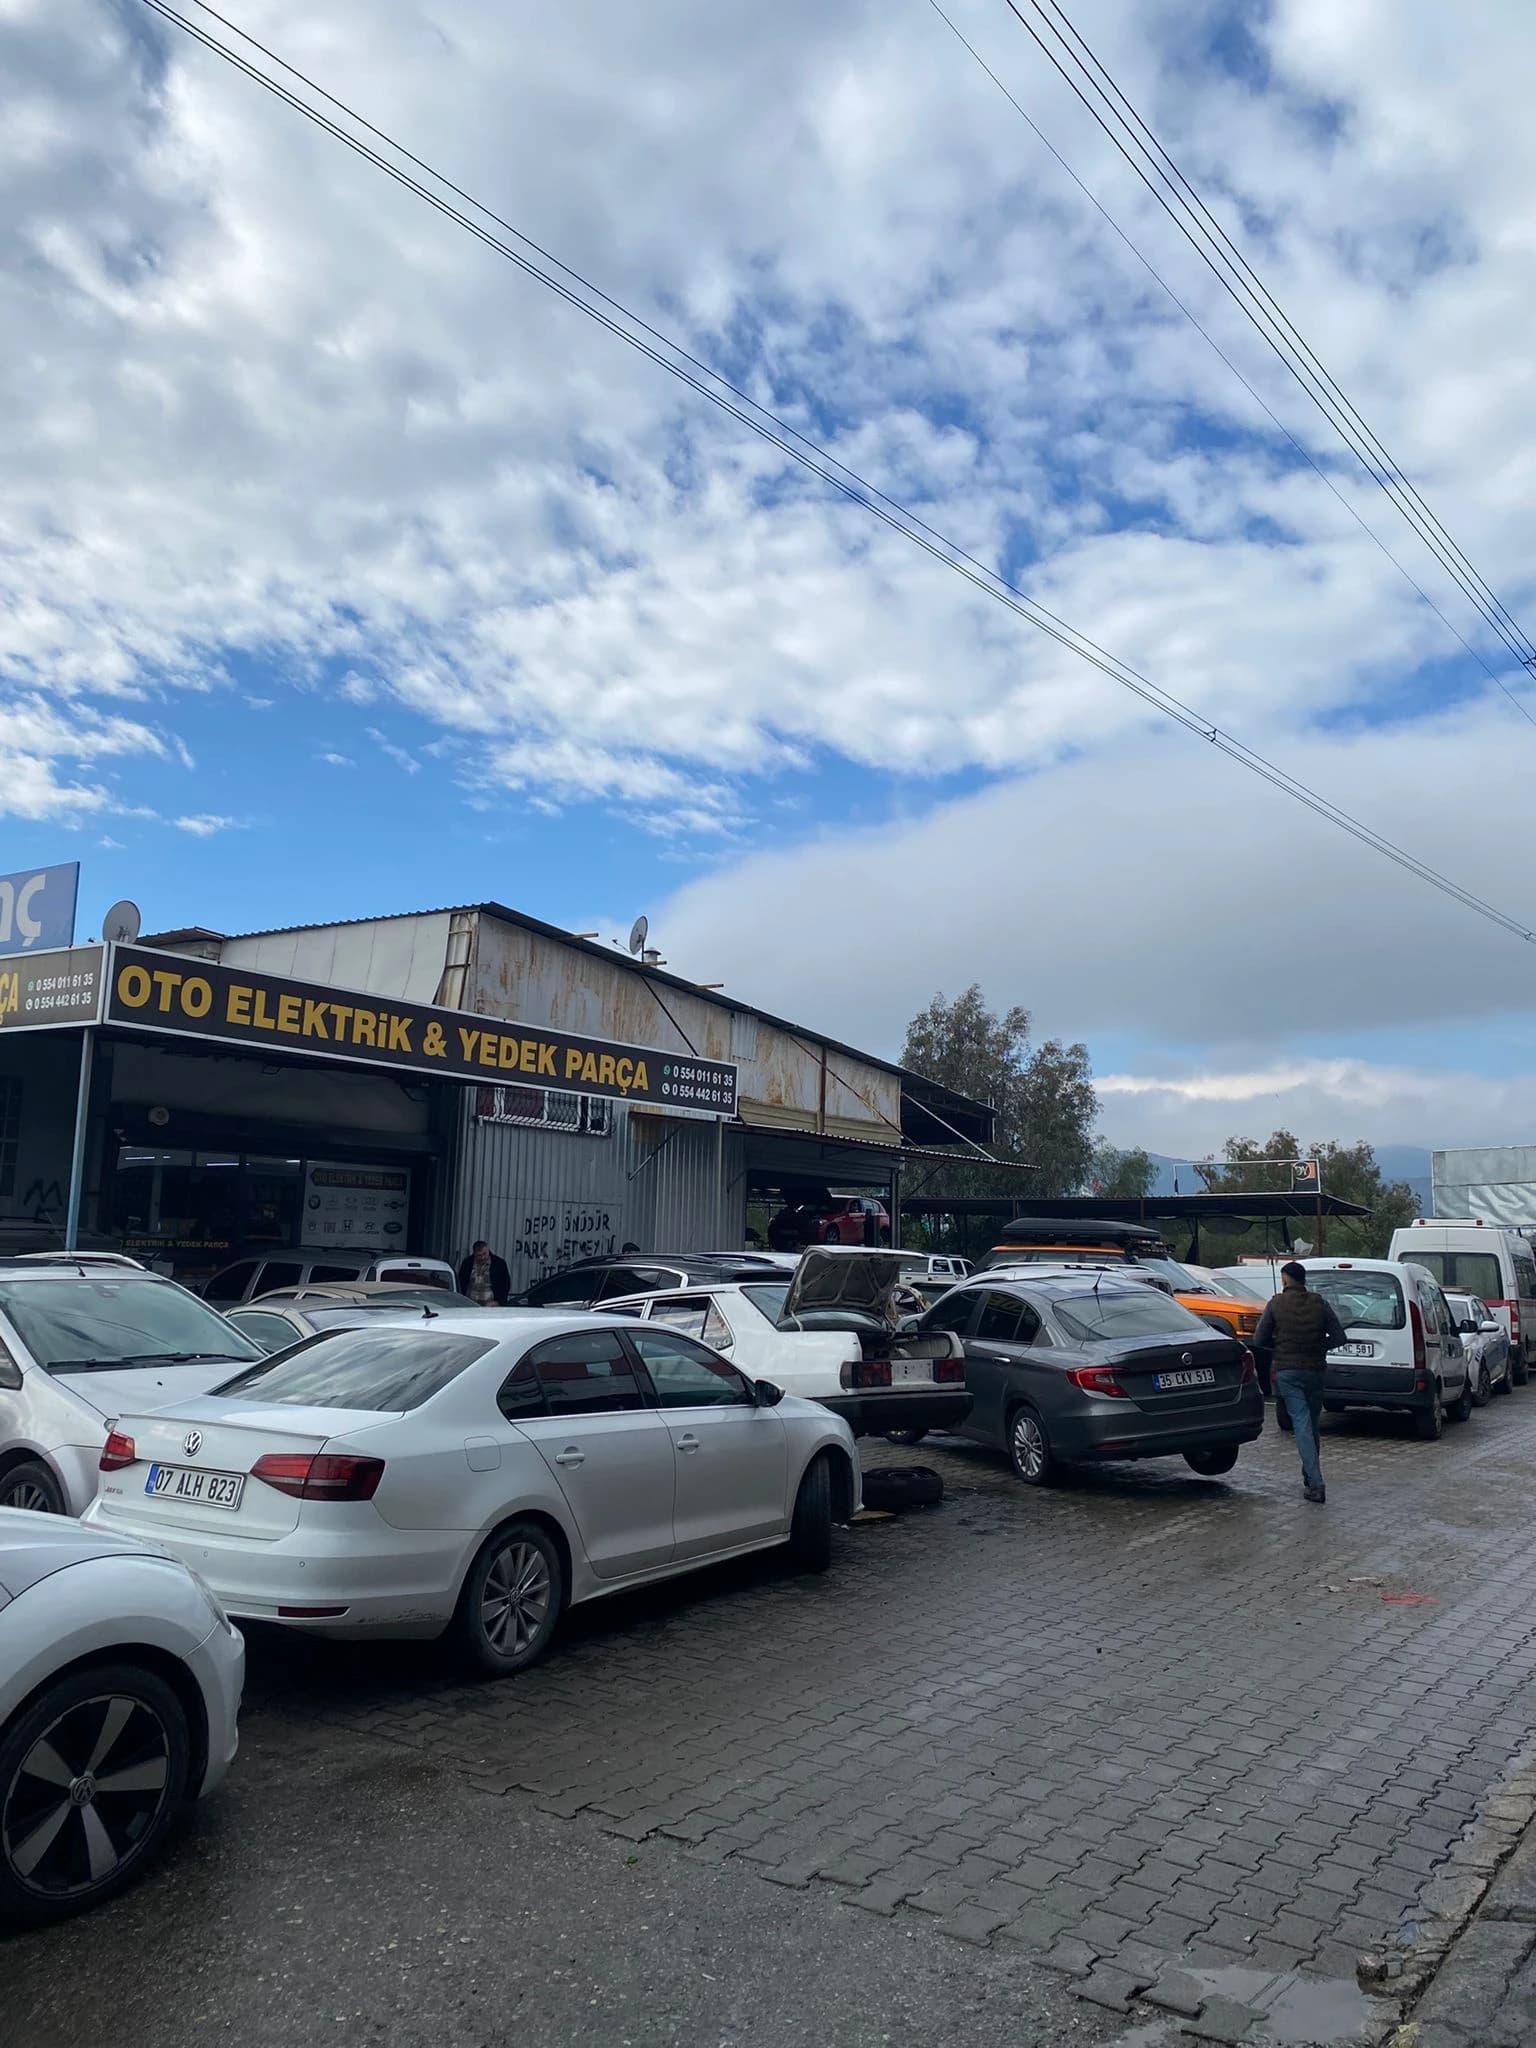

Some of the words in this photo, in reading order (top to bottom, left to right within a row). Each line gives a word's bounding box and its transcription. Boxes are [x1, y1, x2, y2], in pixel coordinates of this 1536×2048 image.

[83, 972, 94, 985] 35
[81, 991, 92, 1004] 35
[117, 964, 213, 1019] OTO
[422, 1020, 448, 1057] &
[458, 1027, 558, 1077] YEDEK
[565, 1048, 649, 1096] PARÇA
[673, 1065, 679, 1078] 0
[680, 1066, 695, 1081] 554
[696, 1069, 711, 1084] 011
[712, 1072, 722, 1085] 61
[723, 1074, 733, 1087] 35
[672, 1083, 679, 1096] 0
[679, 1085, 694, 1098] 554
[695, 1087, 710, 1101] 442
[711, 1090, 721, 1103] 61
[722, 1092, 733, 1104] 35
[525, 1215, 556, 1235] DEPO
[516, 1240, 548, 1259] PARK
[1160, 1375, 1172, 1387] 35
[1196, 1370, 1213, 1382] 513
[155, 1469, 173, 1491] 07
[176, 1472, 204, 1497] ALH
[208, 1478, 236, 1502] 823
